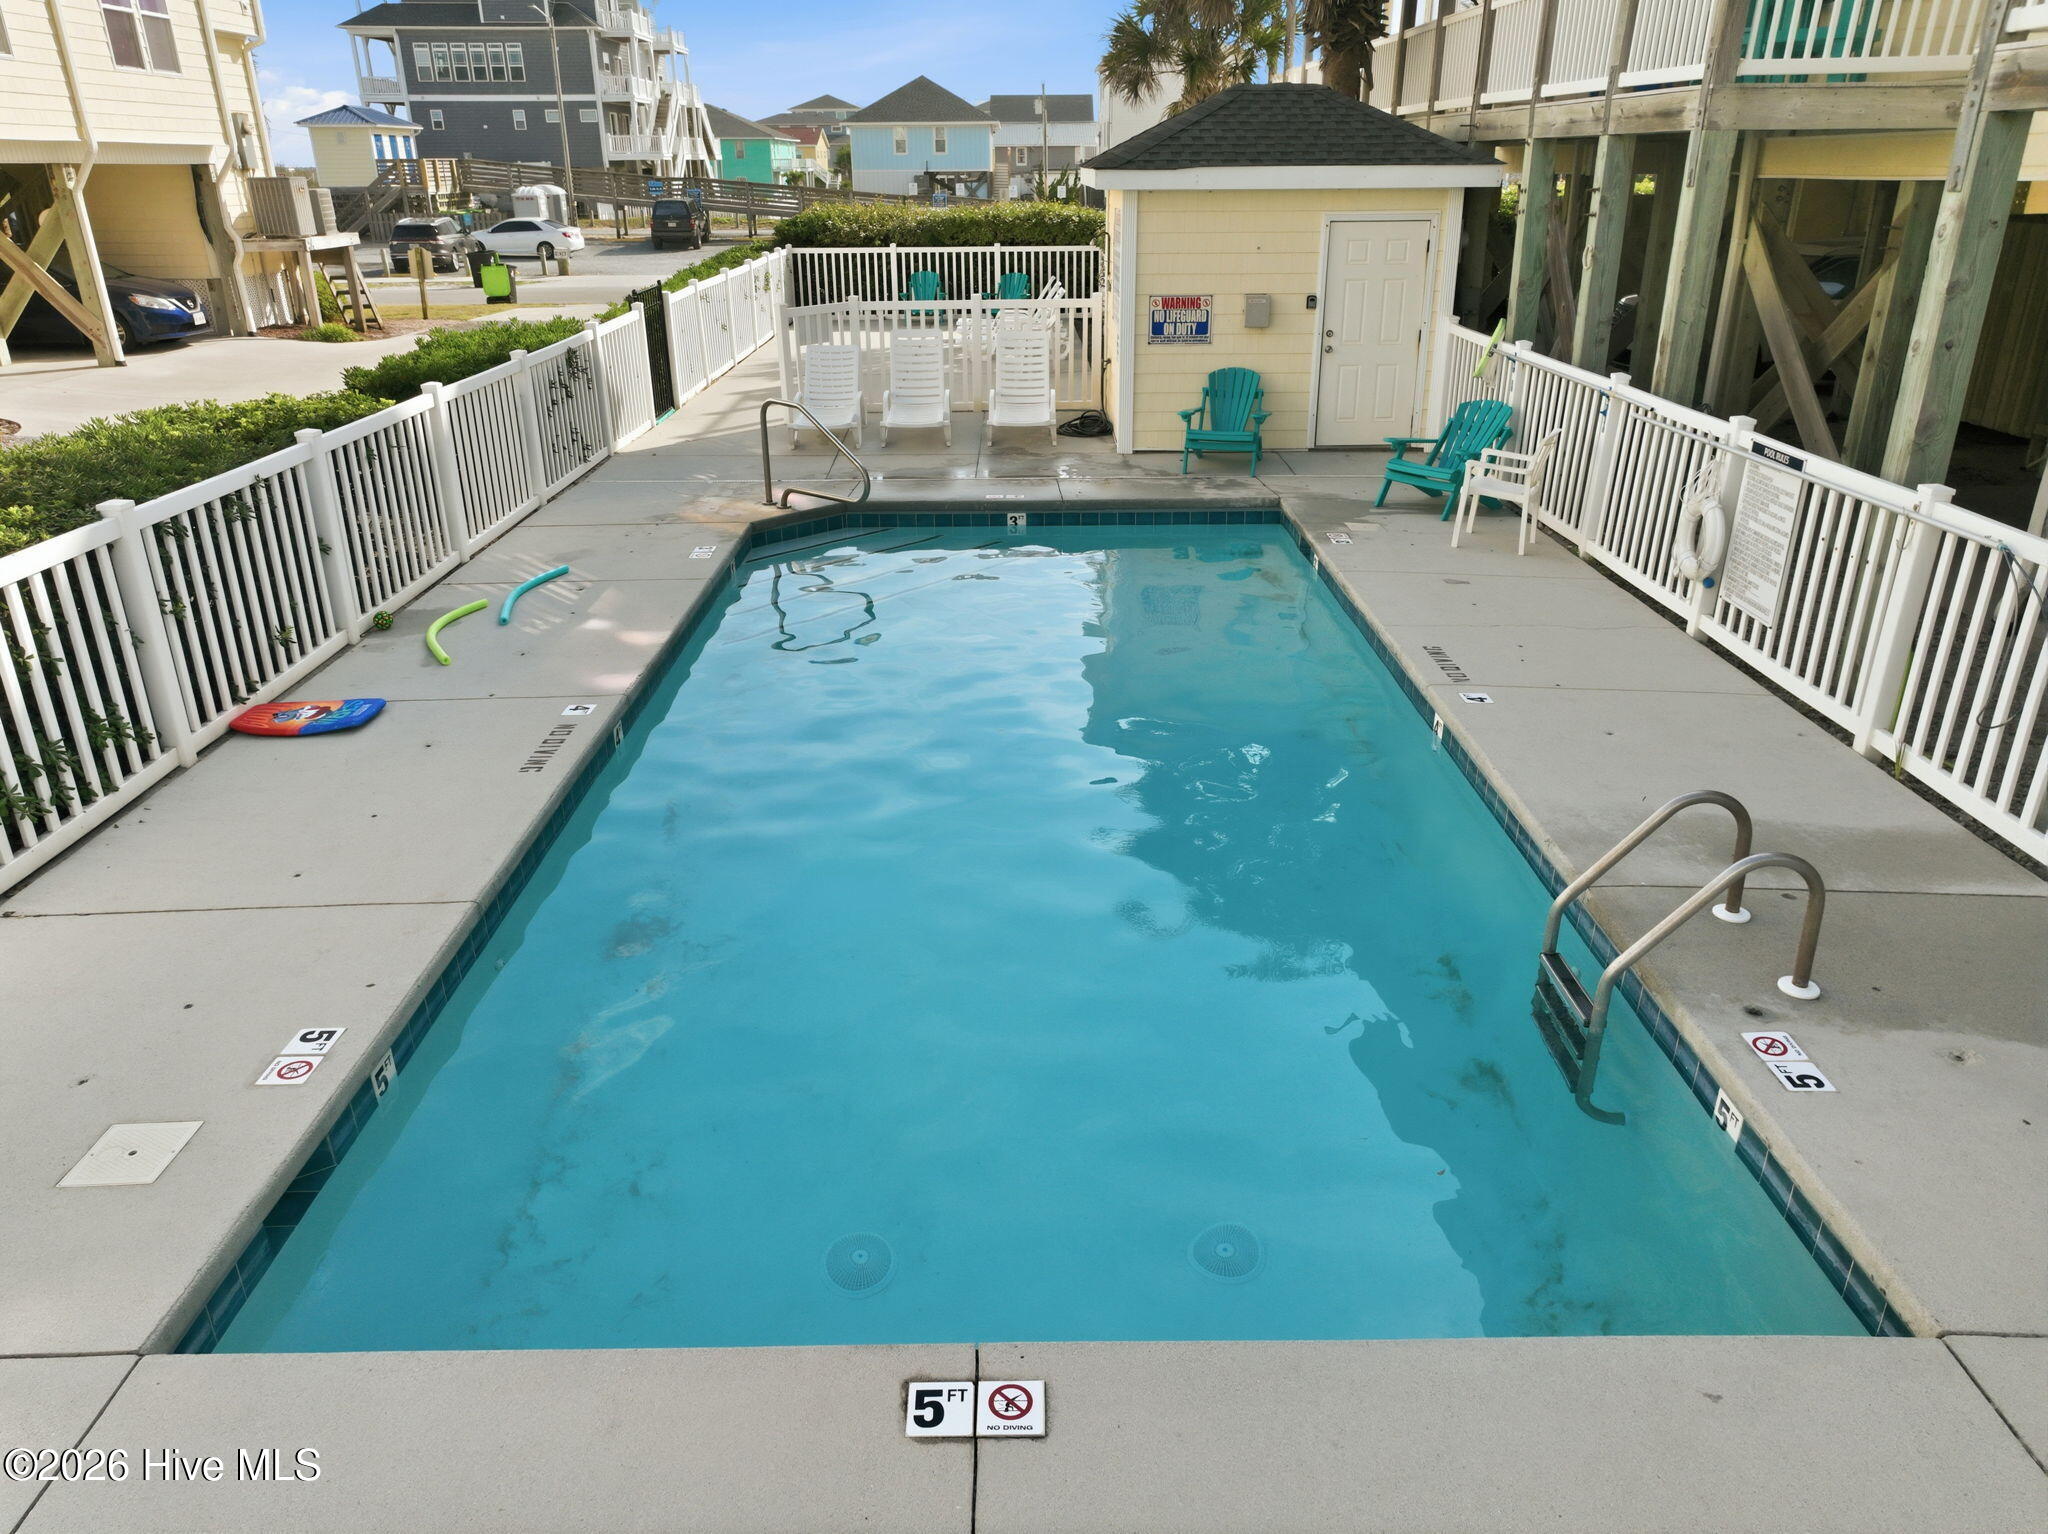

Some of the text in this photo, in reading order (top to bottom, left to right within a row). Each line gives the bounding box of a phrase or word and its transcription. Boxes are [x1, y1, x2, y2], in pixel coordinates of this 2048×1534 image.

[1161, 296, 1202, 309] WARNING
[1153, 310, 1207, 323] NO LIFEGUARD
[1163, 323, 1197, 335] ON DUTY
[1763, 447, 1790, 465] POOL RULES
[1009, 515, 1018, 527] 3
[1422, 645, 1461, 671] DIVING
[518, 723, 578, 773] NO DIVING
[299, 1029, 338, 1052] 5 FT
[374, 1066, 389, 1097] 5
[1774, 1063, 1826, 1089] 5 FT
[1715, 1097, 1740, 1132] 5 FT
[913, 1388, 968, 1429] 5 FT
